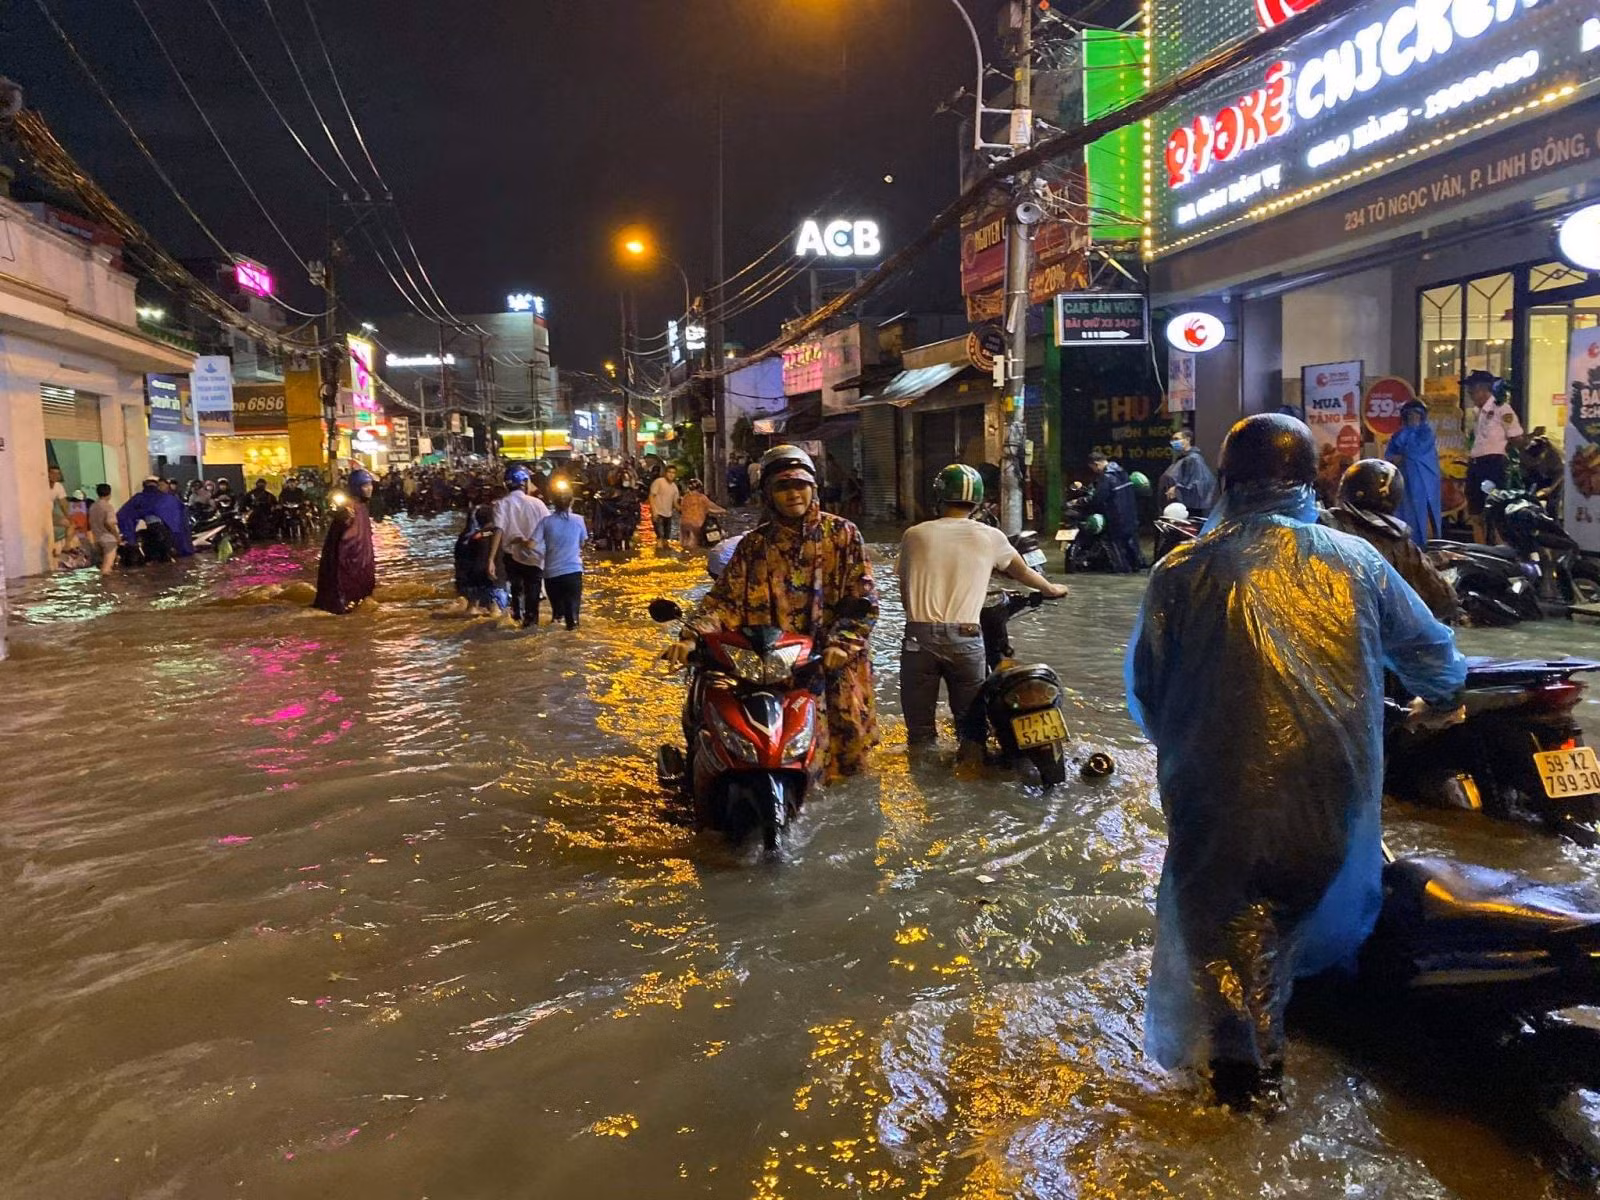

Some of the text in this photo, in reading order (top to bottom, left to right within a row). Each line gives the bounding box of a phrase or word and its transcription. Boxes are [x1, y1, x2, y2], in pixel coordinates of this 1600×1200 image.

[1296, 0, 1541, 119] CHICKE
[1344, 208, 1364, 231] 234
[1368, 200, 1386, 223] TÔ
[1388, 186, 1428, 214] NGỌC
[1431, 174, 1466, 201] VÂN,
[1470, 168, 1484, 191] P.
[1487, 153, 1526, 185] LINH
[1530, 133, 1590, 171] ĐÔNG,
[796, 219, 881, 256] ACB
[247, 396, 285, 411] 6886
[1312, 397, 1342, 410] MUA
[1016, 711, 1054, 730] 77-X1
[1544, 752, 1591, 773] 59-X2
[1545, 771, 1600, 794] 799.30
